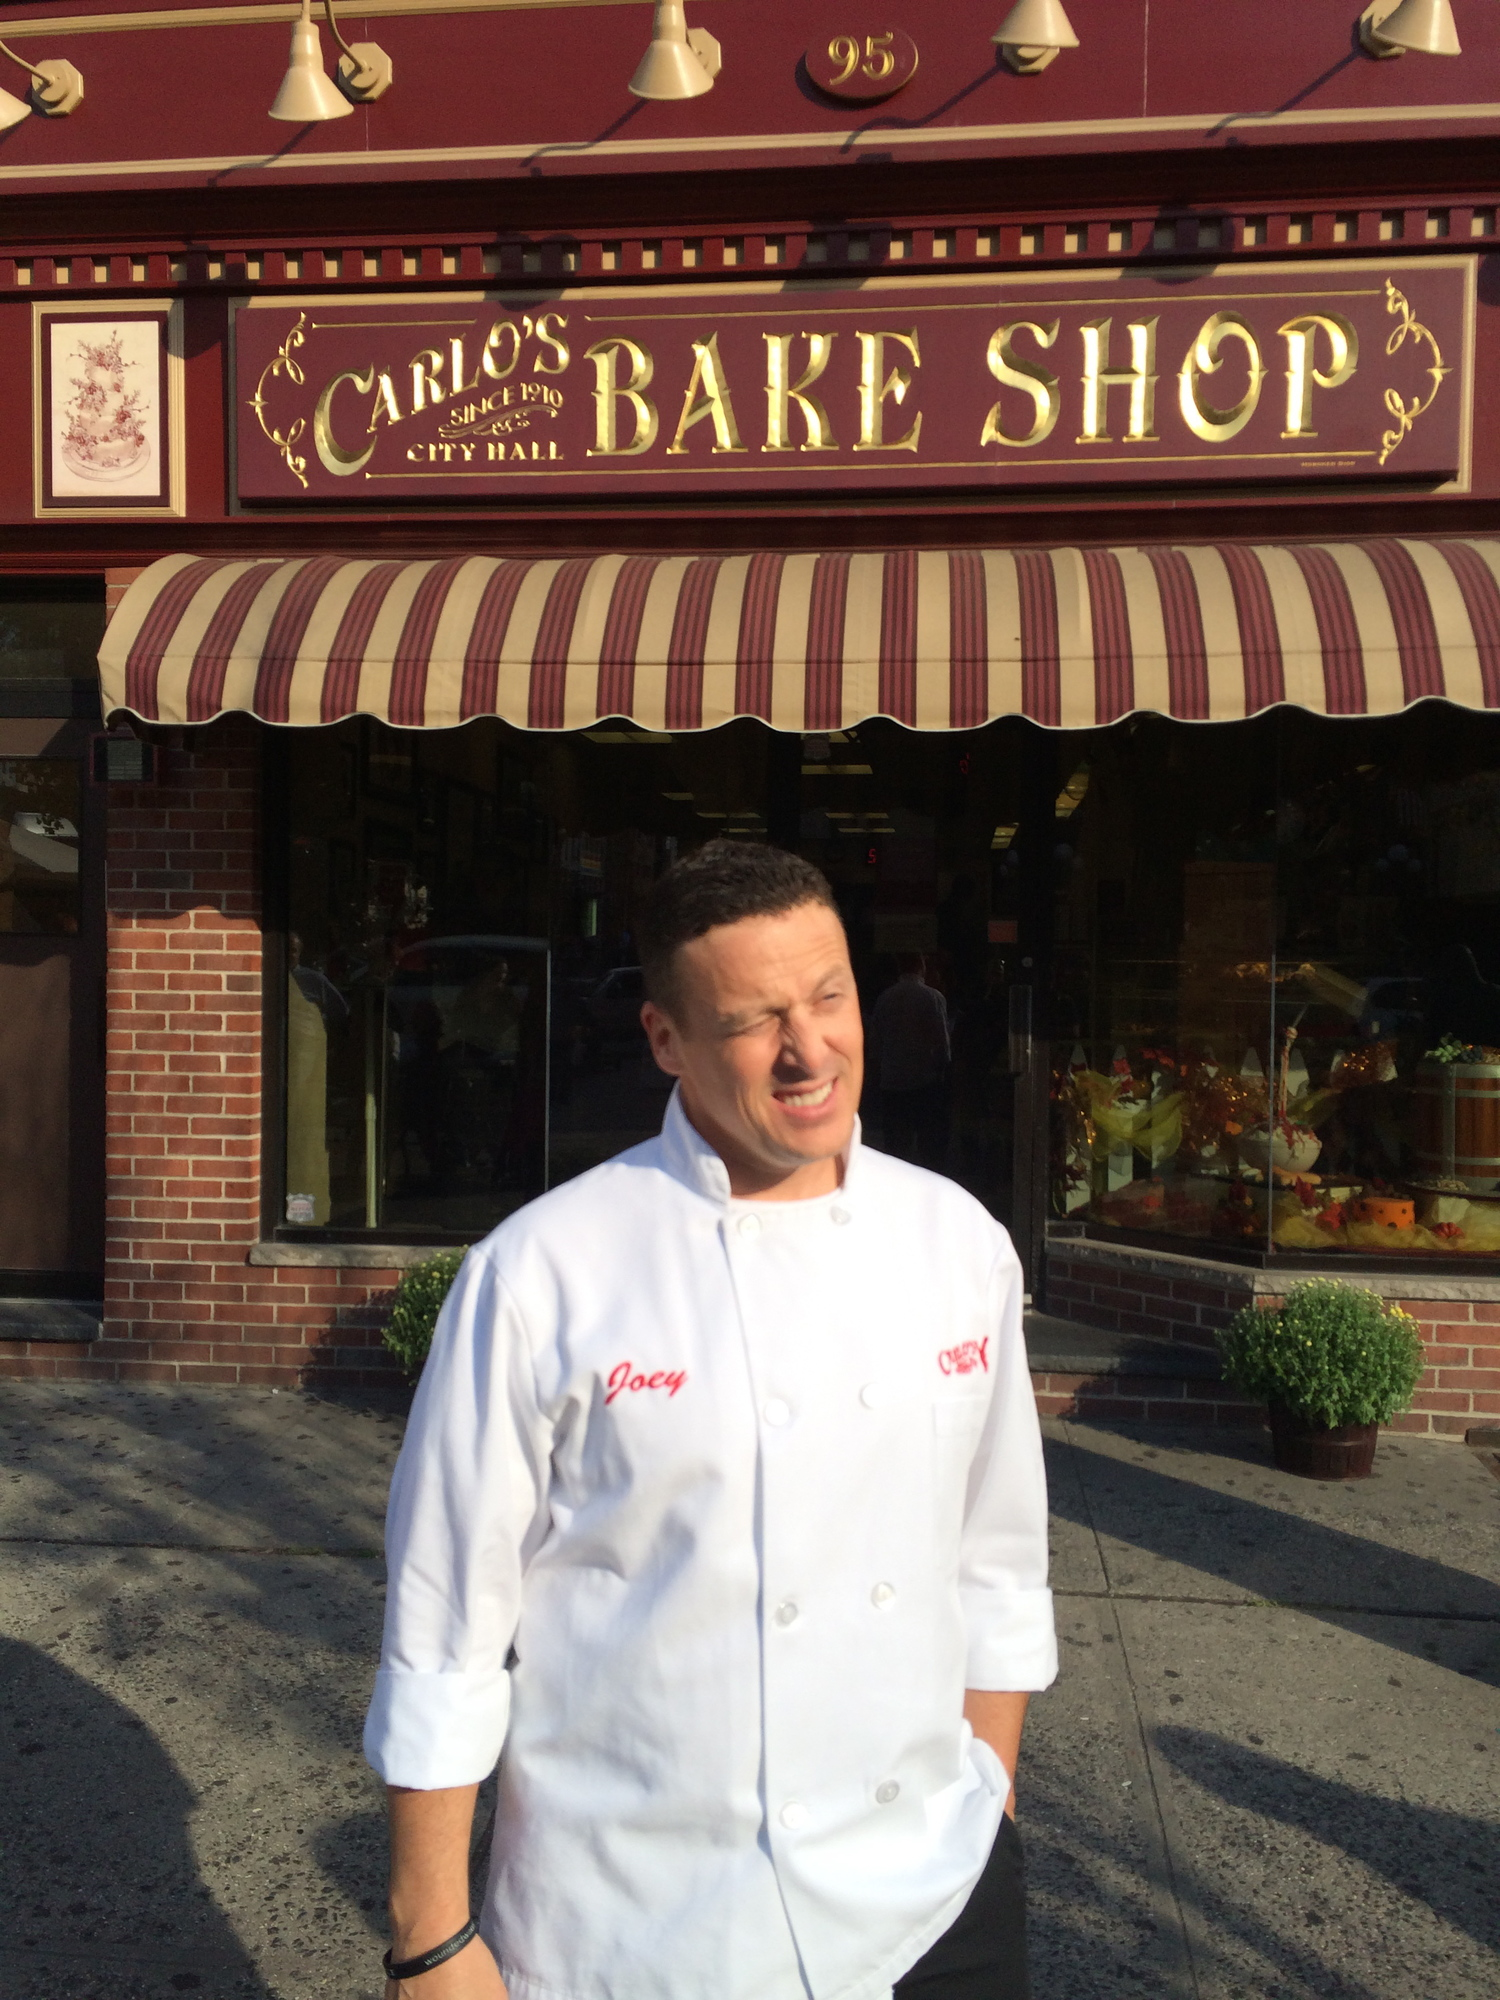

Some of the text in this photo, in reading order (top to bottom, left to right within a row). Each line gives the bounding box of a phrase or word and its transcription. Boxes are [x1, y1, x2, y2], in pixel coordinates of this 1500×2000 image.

[828, 31, 895, 85] 95
[313, 310, 1359, 476] CARLO'S BAKE SHOP
[450, 382, 563, 426] SINCE 1910
[406, 441, 564, 462] CITY HALL
[604, 1361, 688, 1405] Joey
